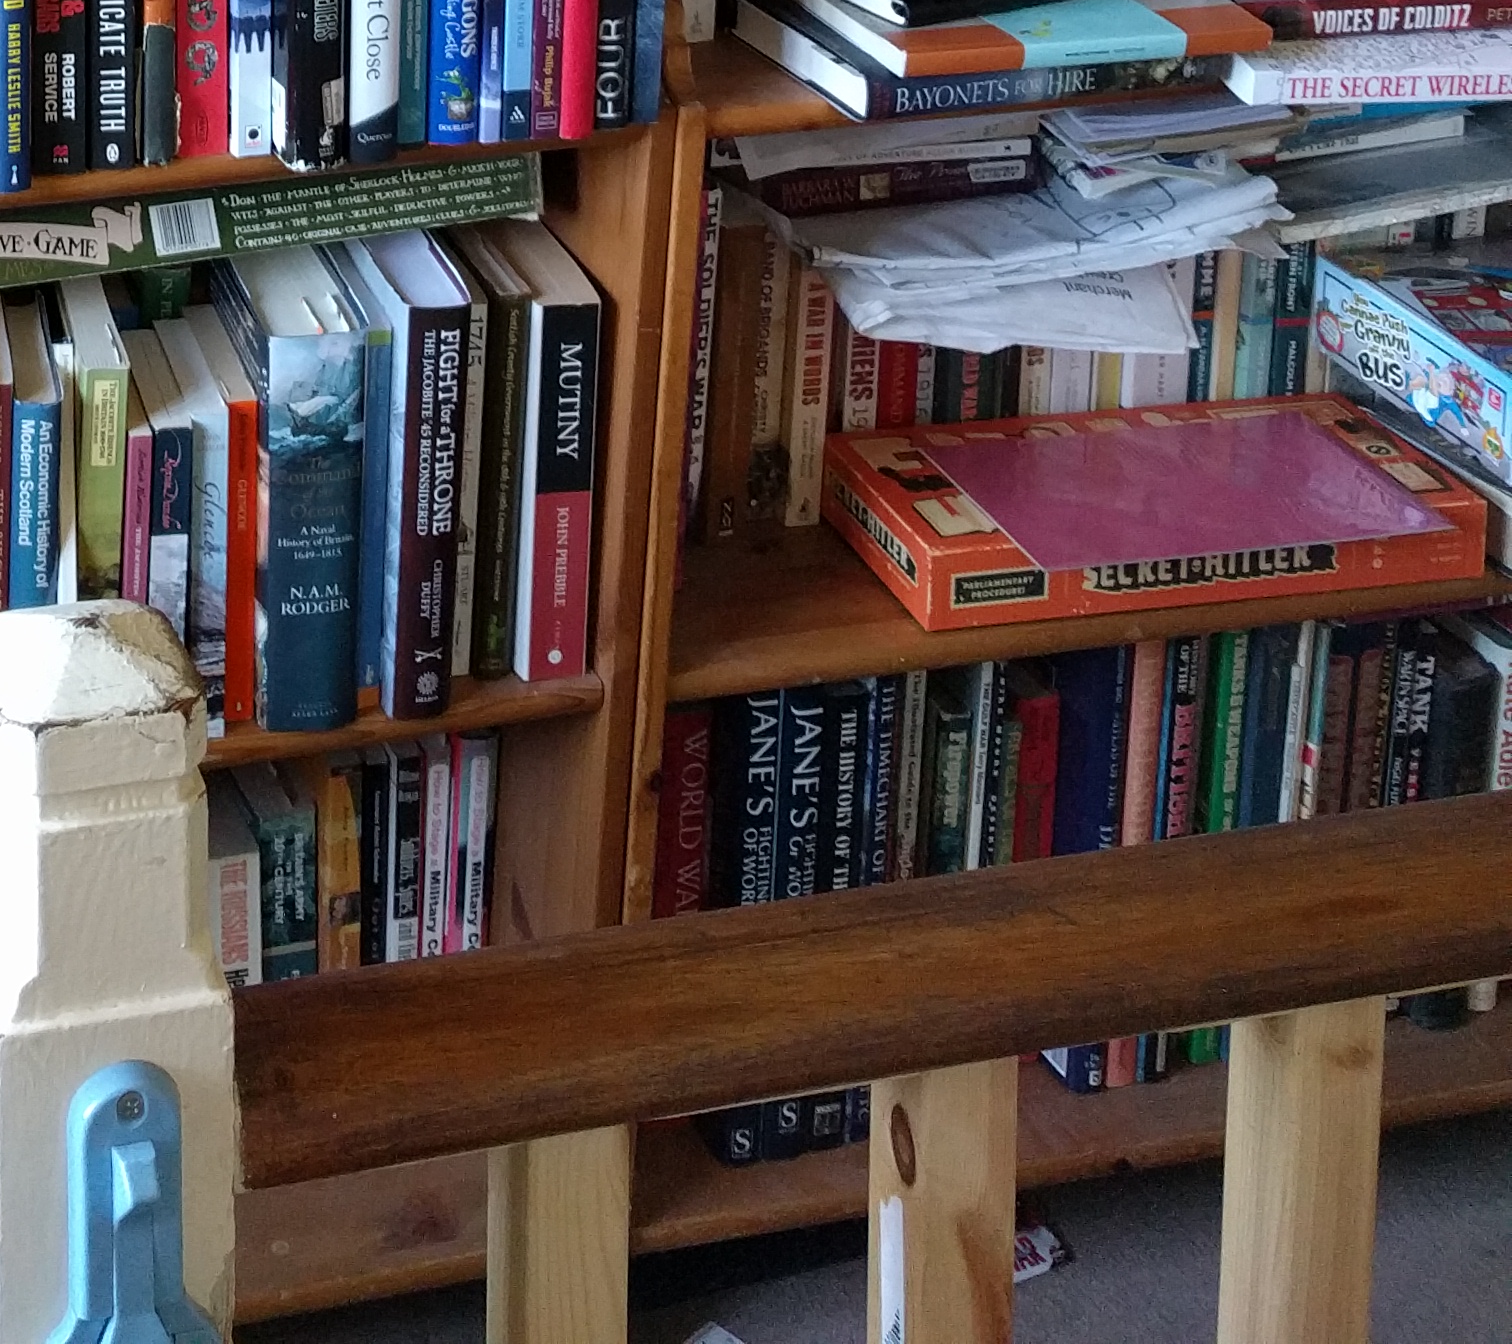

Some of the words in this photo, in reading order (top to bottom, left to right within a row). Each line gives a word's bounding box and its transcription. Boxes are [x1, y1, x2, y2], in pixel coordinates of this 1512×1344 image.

[1312, 8, 1371, 35] VOICES
[1374, 9, 1402, 30] OF
[1404, 4, 1471, 30] COLDITZ
[366, 10, 389, 81] Close
[596, 18, 626, 120] FOUR
[895, 80, 1010, 111] BAYONETS
[35, 230, 99, 258] GAME
[557, 343, 584, 460] MUTINY
